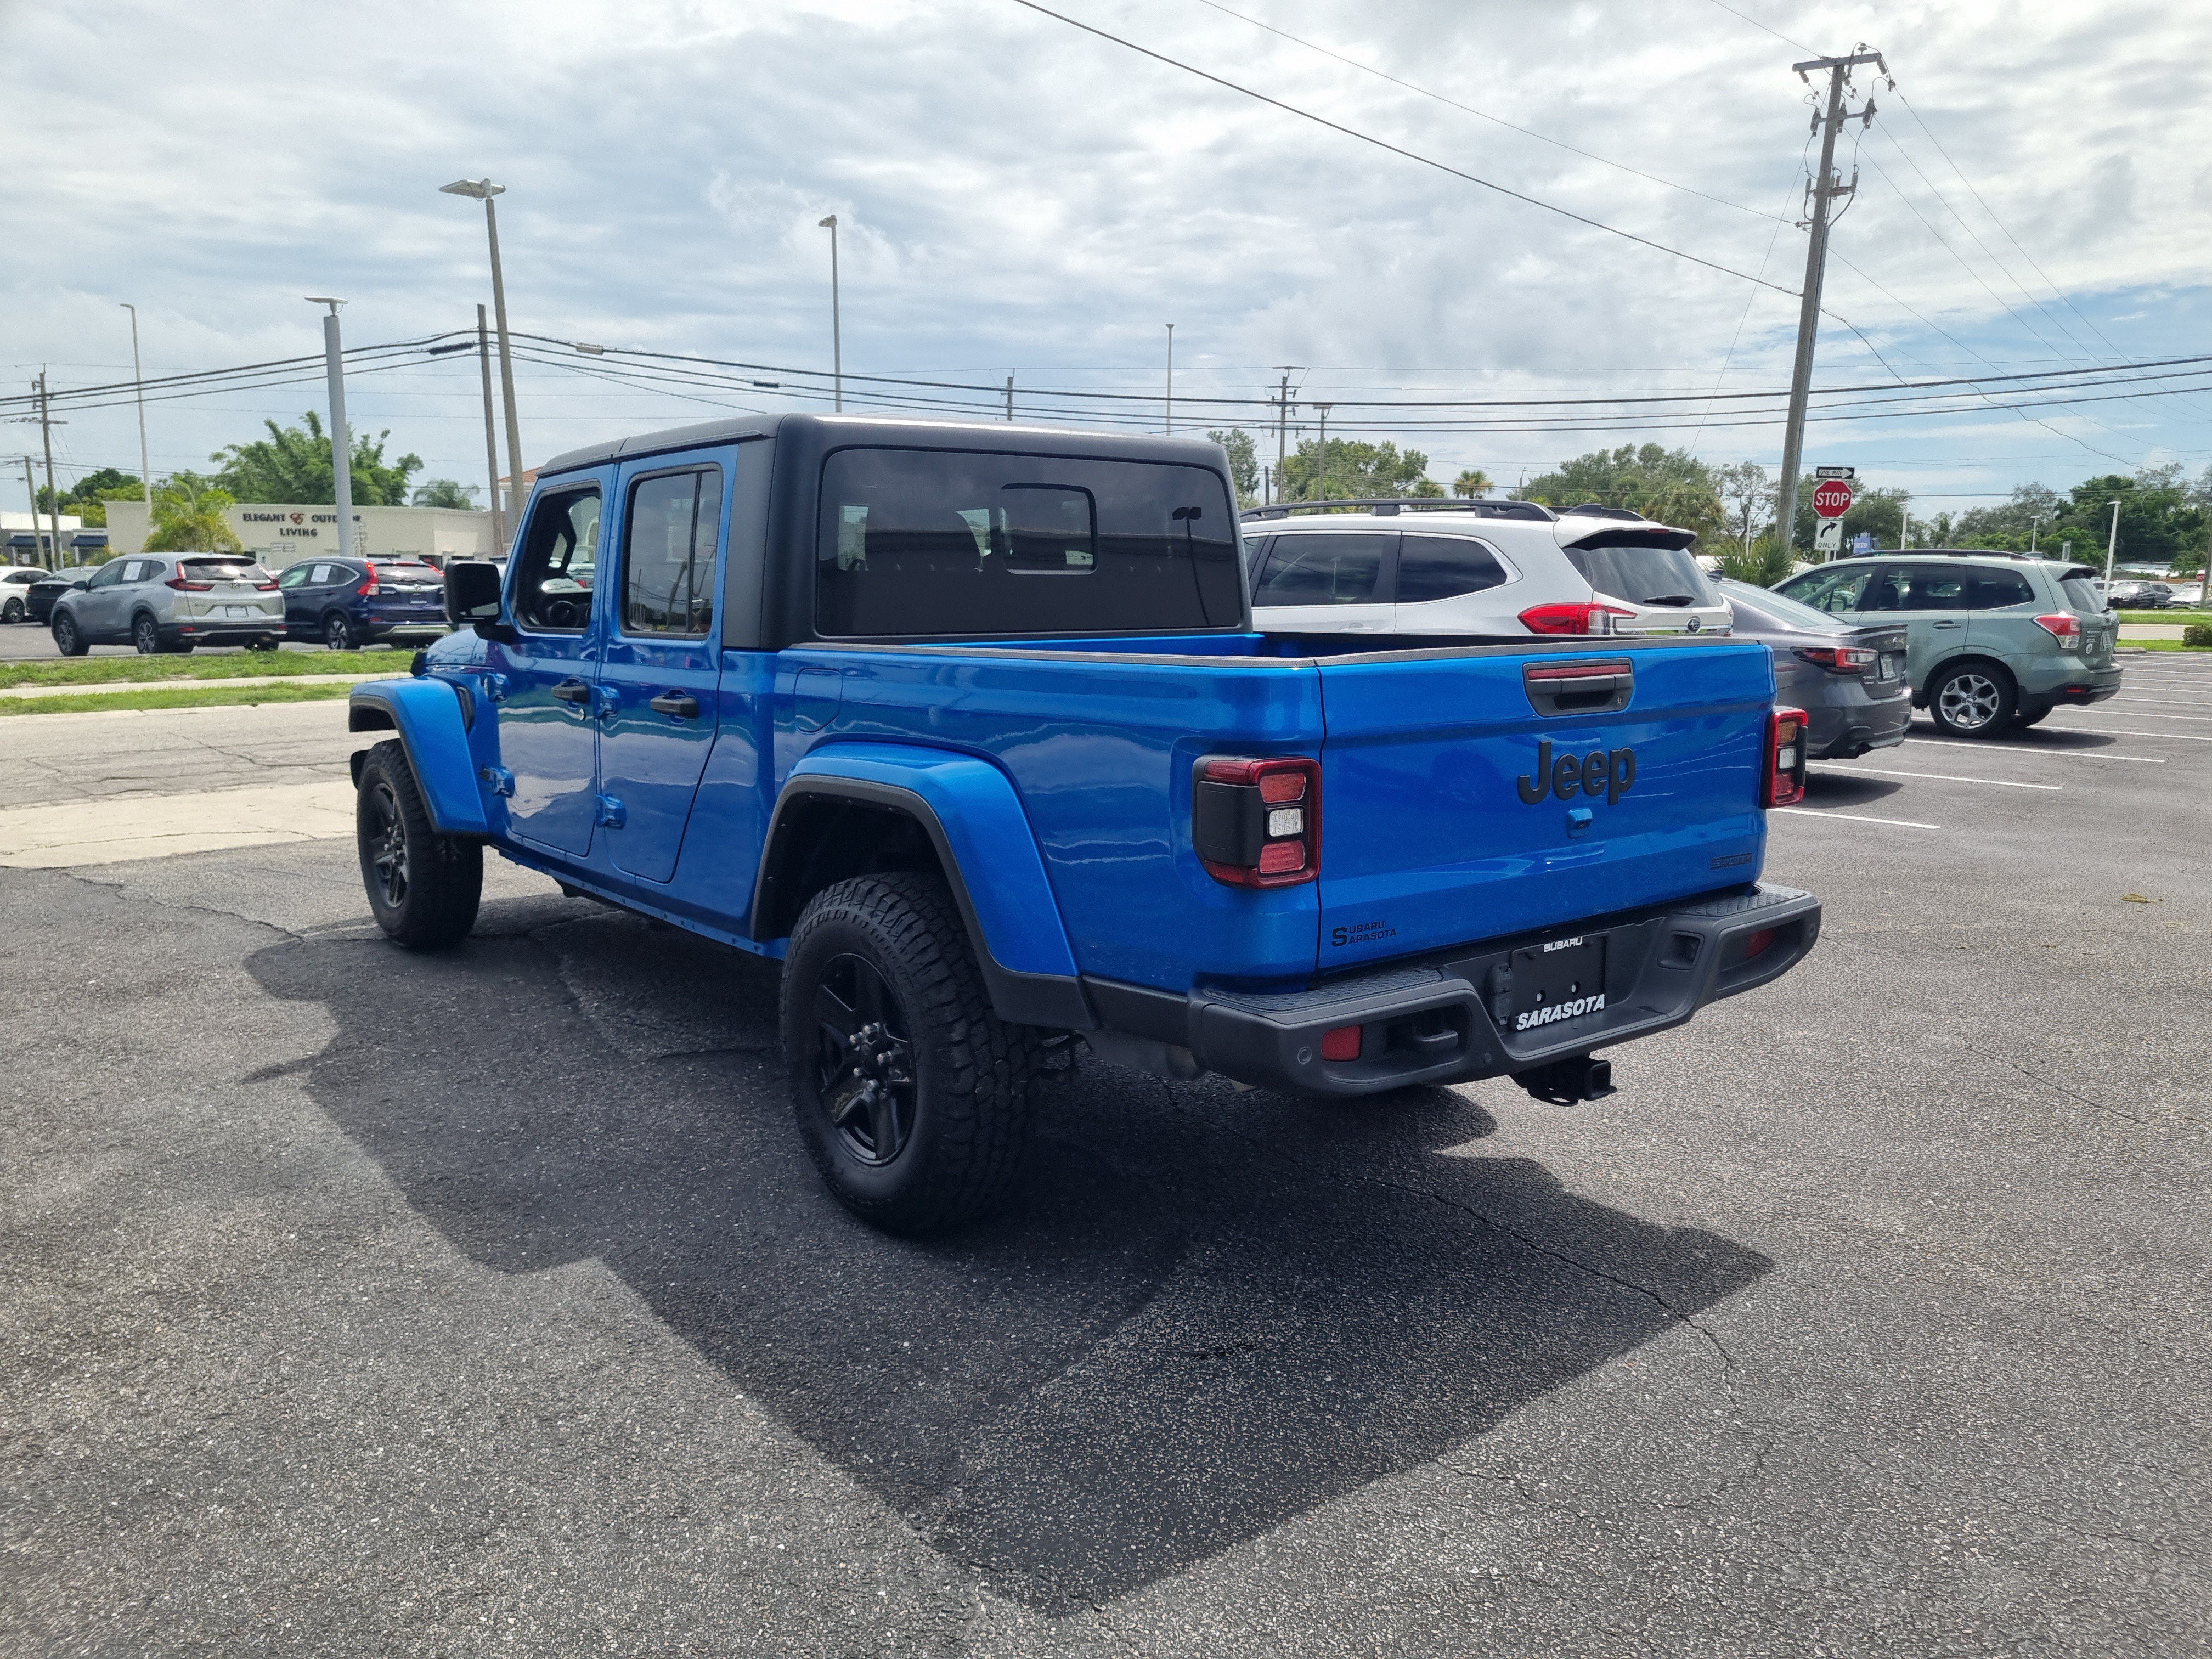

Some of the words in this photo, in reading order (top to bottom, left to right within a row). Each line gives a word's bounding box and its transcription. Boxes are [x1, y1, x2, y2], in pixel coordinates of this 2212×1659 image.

[1815, 492, 1849, 506] STOP
[243, 513, 285, 522] ELEGANT
[280, 528, 318, 537] LIVING
[1517, 741, 1636, 806] Jeep
[1543, 936, 1582, 952] SUBARU
[1516, 994, 1605, 1030] SARASOTA
